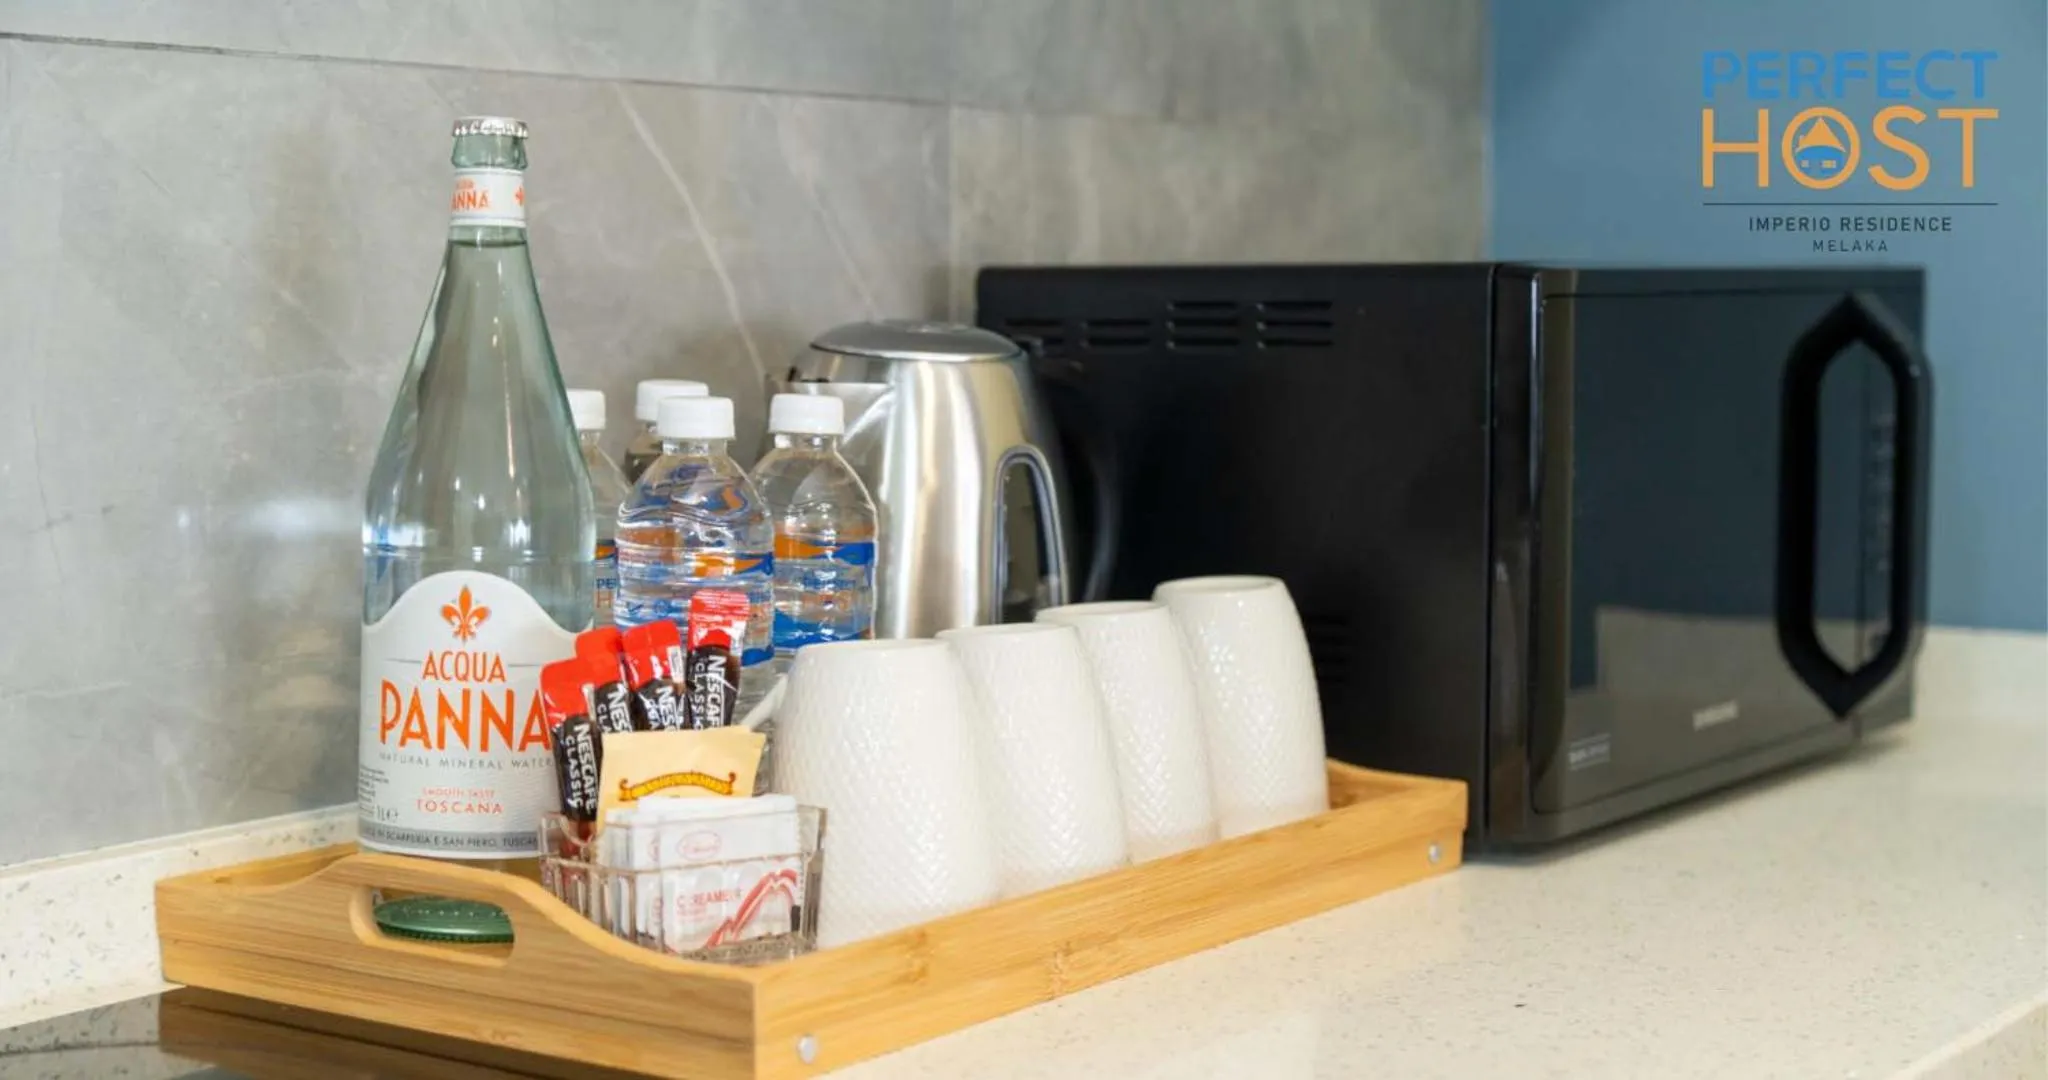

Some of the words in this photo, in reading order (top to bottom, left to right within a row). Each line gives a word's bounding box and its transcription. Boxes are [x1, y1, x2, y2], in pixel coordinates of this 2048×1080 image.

[422, 650, 507, 682] ACQUA
[380, 678, 551, 754] PANNA
[379, 752, 431, 768] NATURAL
[438, 756, 503, 771] MINERAL
[564, 734, 584, 808] CLASSIC
[416, 799, 504, 815] TOSCANA
